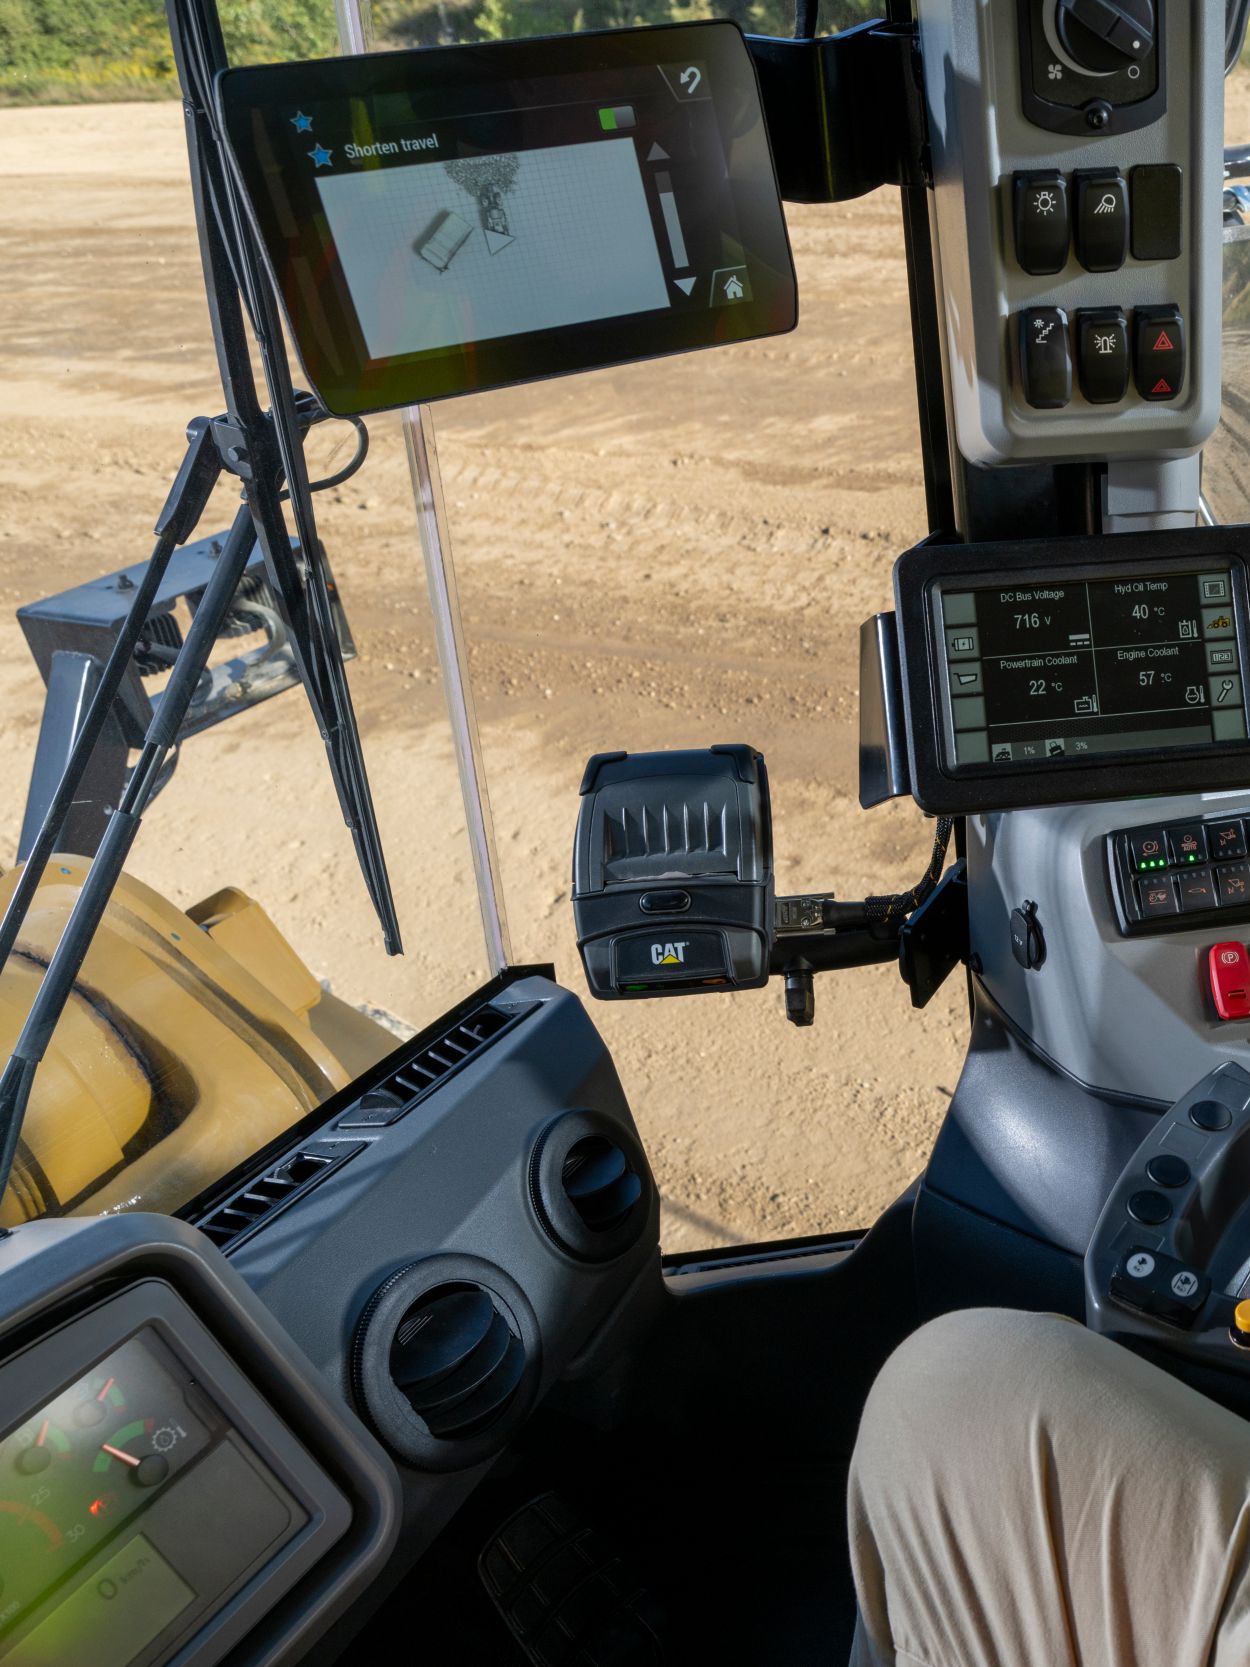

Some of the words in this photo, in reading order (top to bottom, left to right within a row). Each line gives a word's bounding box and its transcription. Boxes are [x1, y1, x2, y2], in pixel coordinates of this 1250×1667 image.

[343, 142, 399, 159] Shorten
[400, 133, 439, 151] travel
[1114, 584, 1132, 595] Hyd
[1132, 582, 1144, 592] Oil
[1145, 581, 1168, 592] Temp
[1000, 592, 1014, 603] DC
[1016, 591, 1032, 601] Bus
[1033, 590, 1065, 600] Voltage
[1132, 604, 1149, 619] 40
[1153, 606, 1166, 616] °C
[1013, 612, 1040, 630] 716
[1117, 649, 1146, 661] Engine
[1147, 646, 1179, 657] Coolant
[1000, 657, 1044, 670] Powertrain
[1045, 655, 1078, 666] Coolant
[1139, 670, 1155, 686] 57
[1160, 673, 1172, 682] °C
[1029, 679, 1047, 695] 22
[1051, 682, 1063, 691] °C
[1023, 745, 1036, 755] 1%
[1075, 741, 1088, 751] 3%
[650, 941, 686, 965] CAT
[31, 1485, 51, 1506] 25
[64, 1523, 86, 1544] 30
